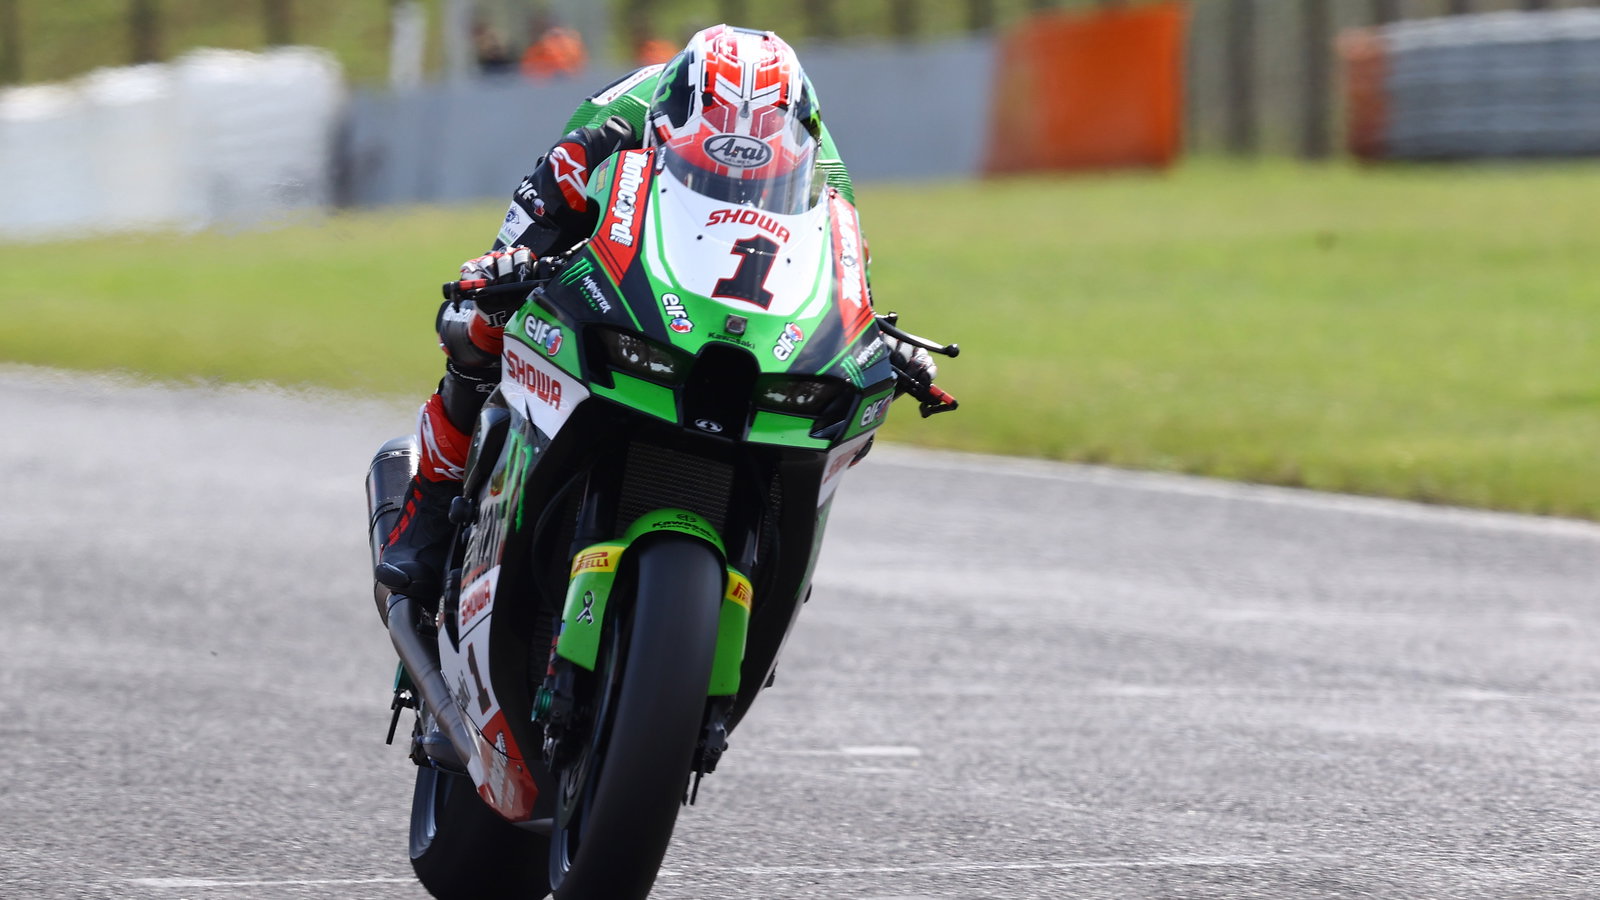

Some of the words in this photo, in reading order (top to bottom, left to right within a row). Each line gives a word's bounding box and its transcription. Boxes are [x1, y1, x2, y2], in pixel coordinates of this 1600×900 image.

[709, 137, 766, 160] Arai
[705, 209, 791, 243] SHOWA
[711, 234, 780, 311] 1
[661, 293, 687, 323] elf
[524, 313, 551, 345] elf
[772, 331, 797, 361] elf
[506, 350, 563, 411] SHOWA
